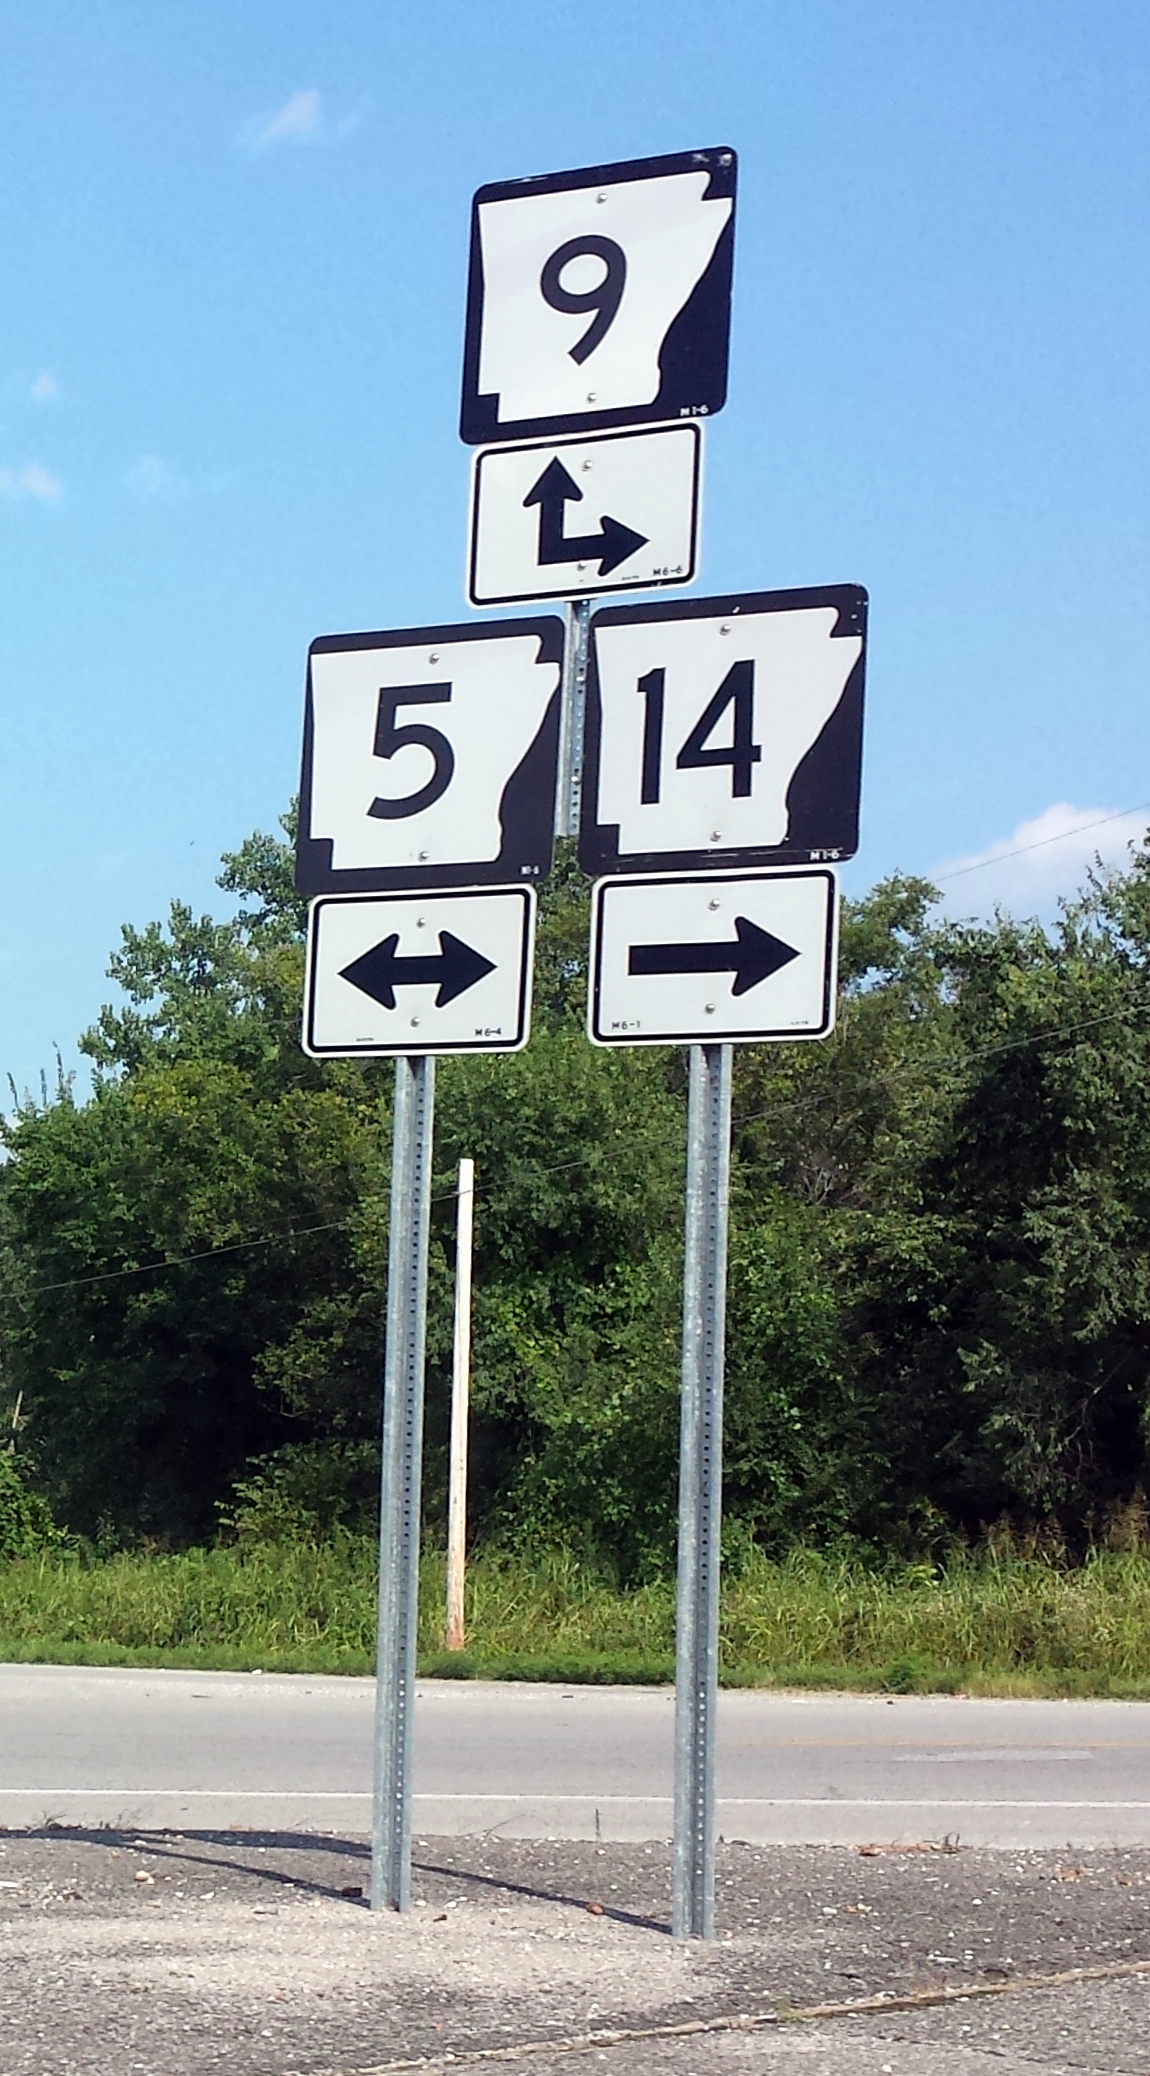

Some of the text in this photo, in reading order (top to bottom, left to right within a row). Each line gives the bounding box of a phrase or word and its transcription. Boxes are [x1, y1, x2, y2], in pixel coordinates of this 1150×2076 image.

[541, 234, 627, 366] 9
[367, 682, 455, 820] 5
[637, 659, 762, 806] 14
